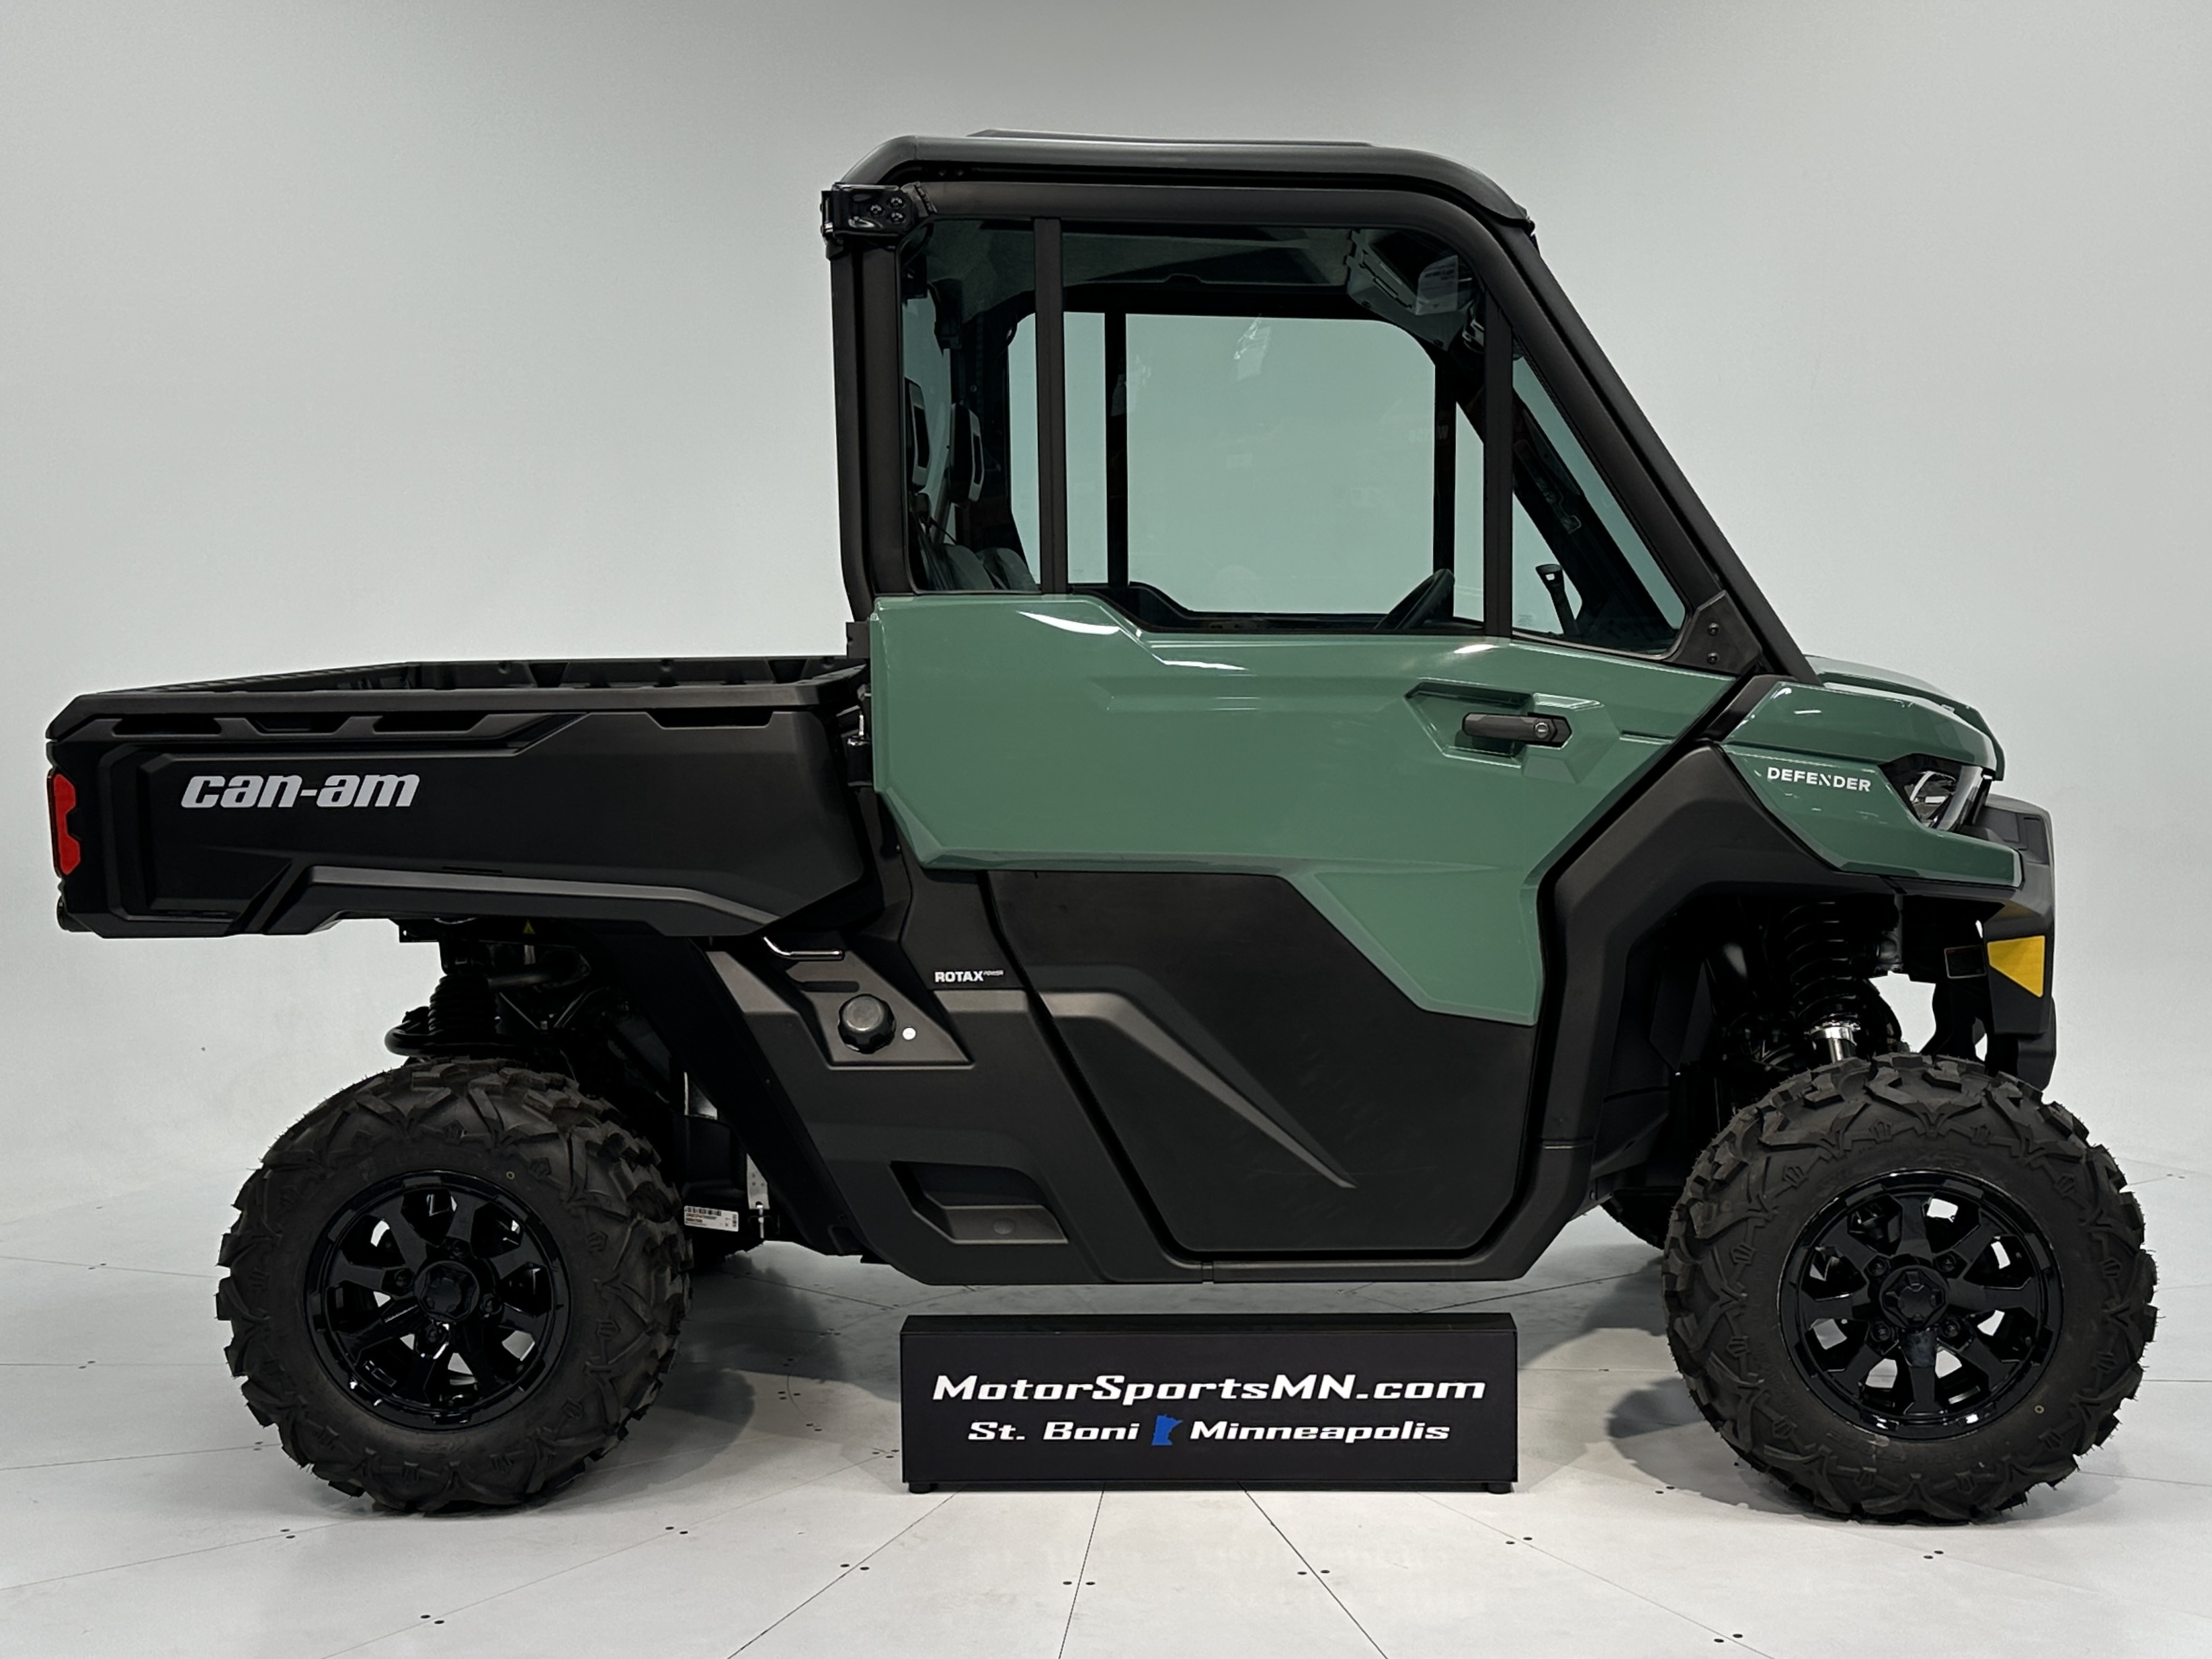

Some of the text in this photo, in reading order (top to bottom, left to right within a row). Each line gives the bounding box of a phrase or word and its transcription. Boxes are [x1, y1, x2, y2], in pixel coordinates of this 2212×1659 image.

[181, 774, 420, 808] can-am
[1767, 767, 1871, 792] DEFENDER
[935, 971, 984, 982] ROTAX
[933, 1375, 1485, 1405] MotorSportsMN.com
[969, 1420, 1450, 1443] St. Boni Minneapolis
